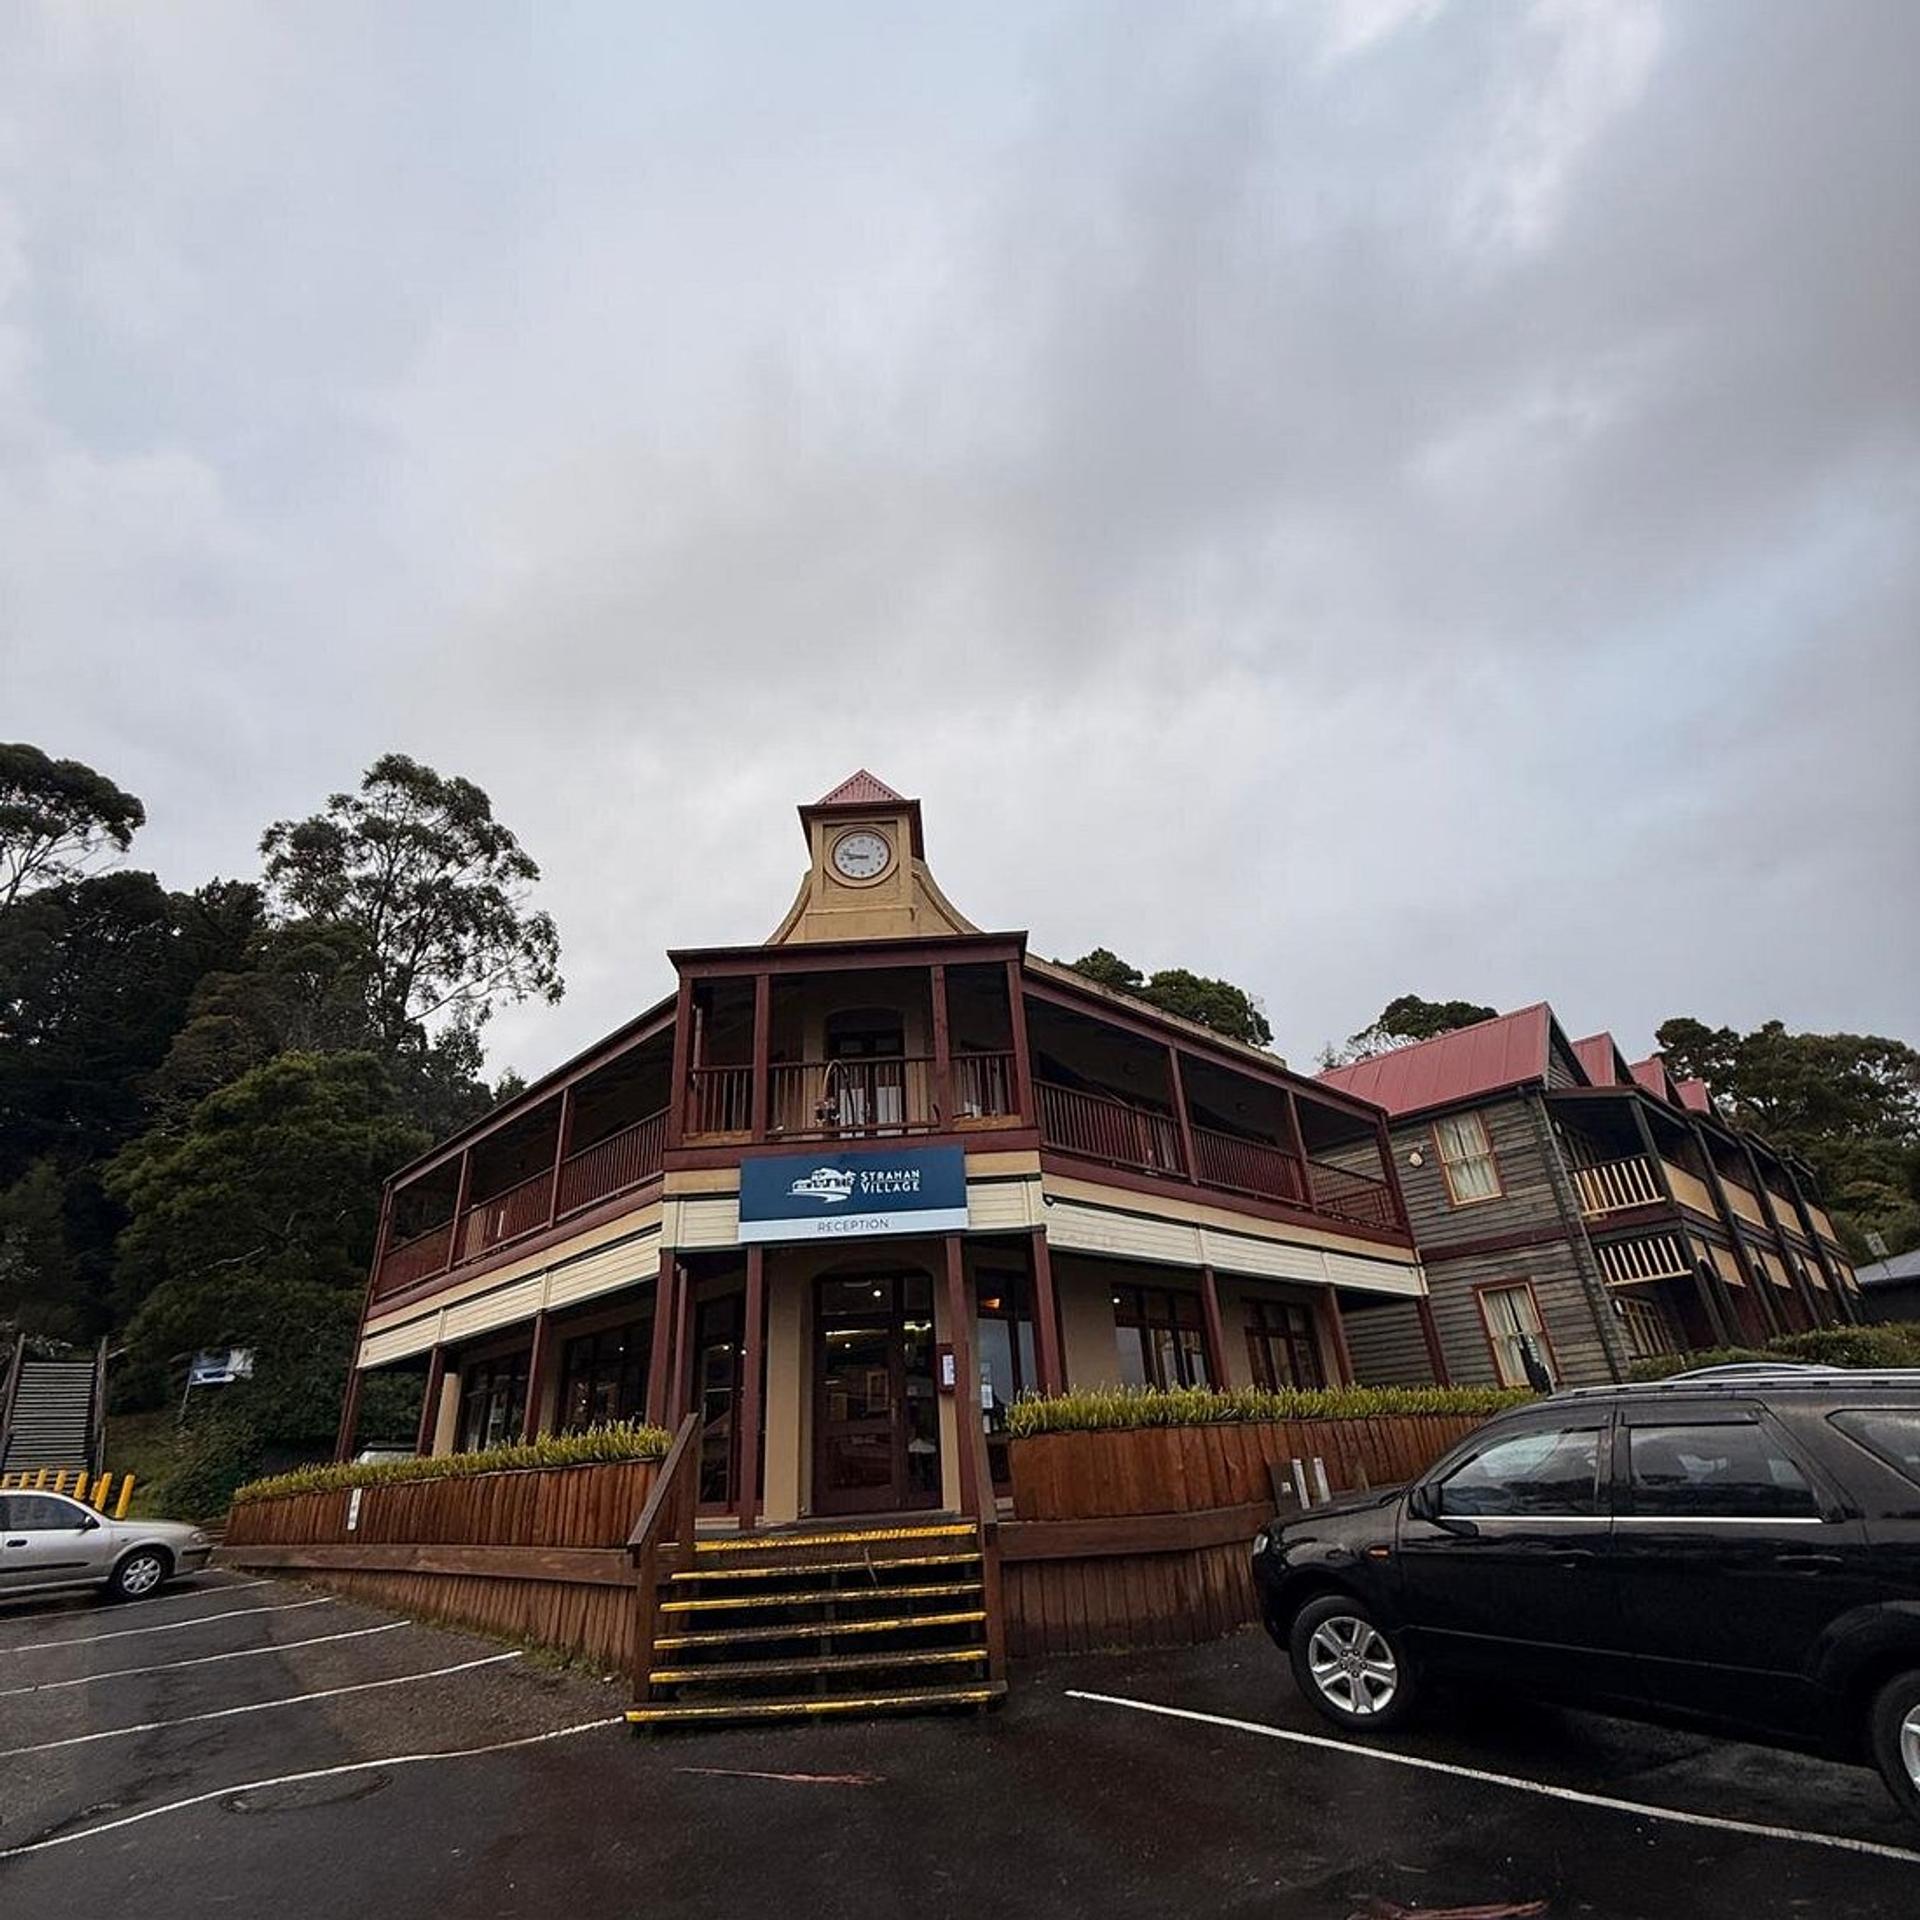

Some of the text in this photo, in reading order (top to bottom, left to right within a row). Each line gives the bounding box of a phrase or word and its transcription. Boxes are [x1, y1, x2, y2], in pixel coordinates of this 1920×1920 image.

[860, 1169, 920, 1181] STRAHAN
[860, 1181, 920, 1194] VILLAGE
[817, 1219, 889, 1233] RECEPTION
